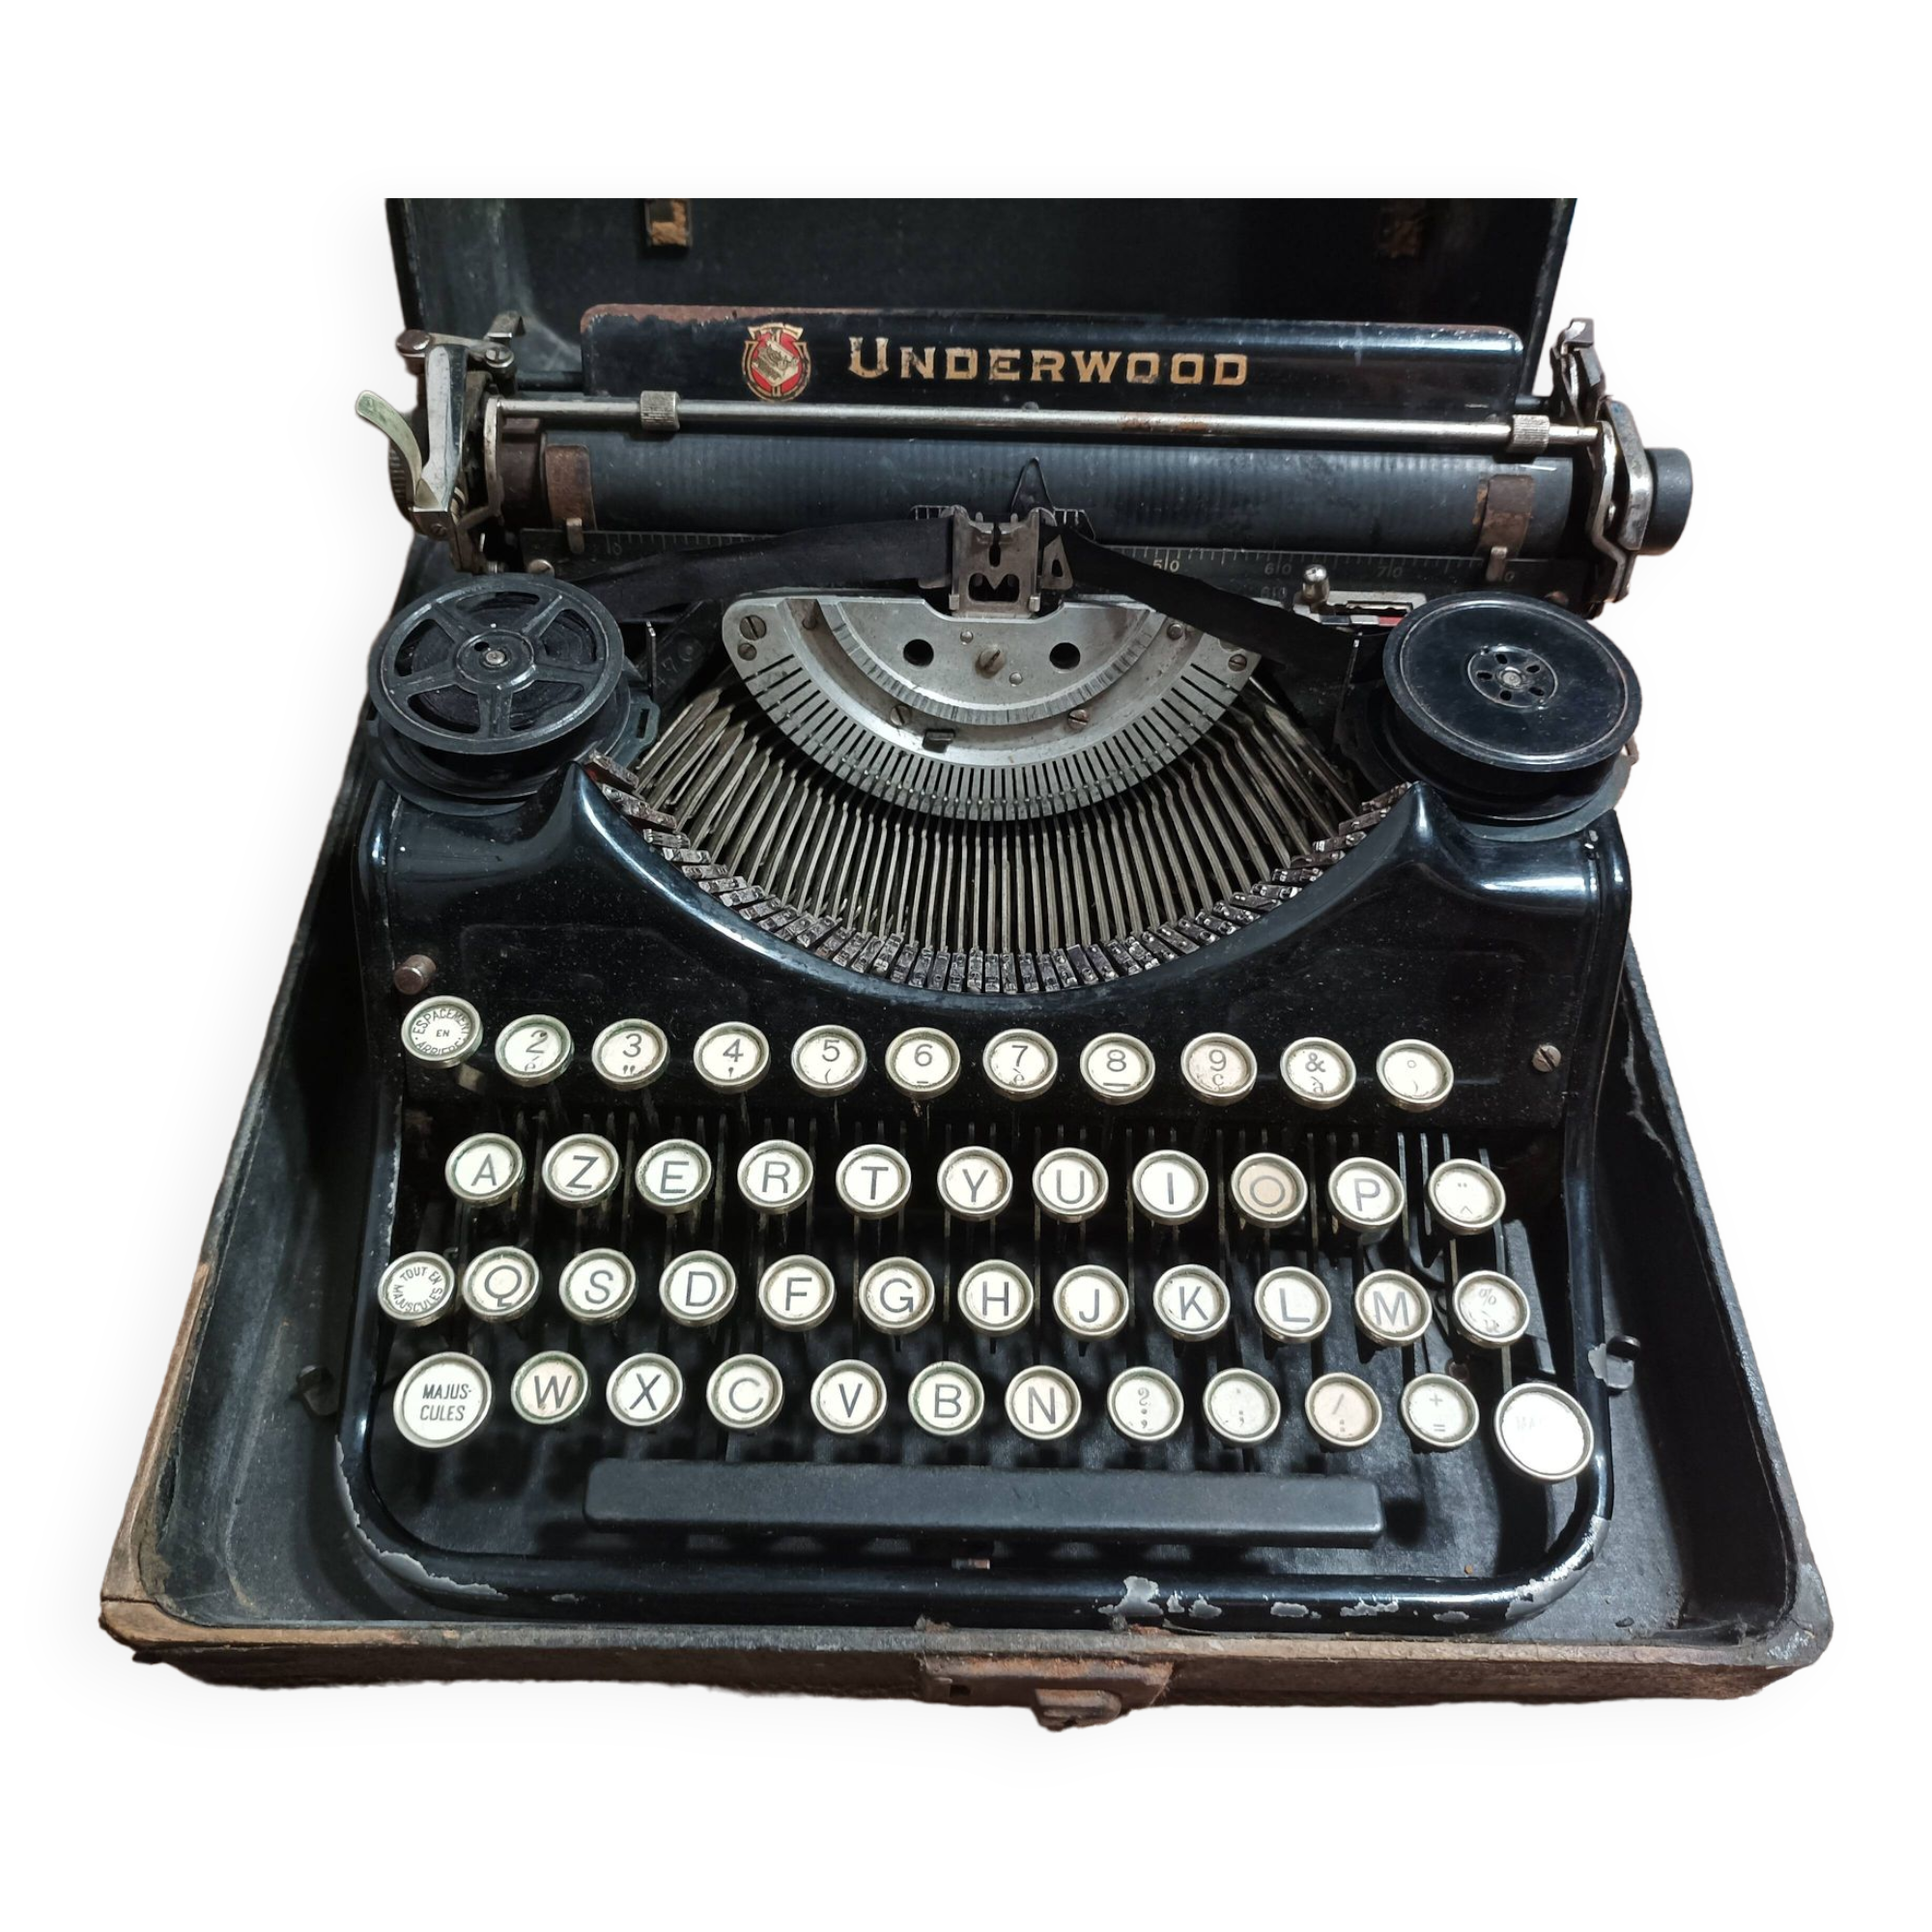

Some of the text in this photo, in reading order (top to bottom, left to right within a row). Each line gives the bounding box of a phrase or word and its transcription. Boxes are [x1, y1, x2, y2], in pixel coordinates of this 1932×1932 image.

[848, 336, 1249, 386] UNDERWOOD
[436, 1029, 460, 1037] EN
[525, 1030, 550, 1054] 2
[622, 1033, 642, 1058] 3
[722, 1038, 745, 1063] 4
[821, 1038, 840, 1063] 5
[913, 1043, 934, 1067] 6
[1010, 1044, 1030, 1067] 7
[1105, 1049, 1128, 1073] 8
[1208, 1048, 1228, 1072] 9
[1304, 1052, 1326, 1073] &
[470, 1153, 498, 1186] A
[565, 1154, 600, 1190] Z
[660, 1160, 690, 1195] E
[761, 1161, 789, 1195] R
[861, 1165, 890, 1201] T
[962, 1169, 989, 1204] Y
[1055, 1169, 1085, 1205] U
[1166, 1172, 1175, 1206] I
[1249, 1175, 1286, 1208] O
[1353, 1178, 1381, 1211] P
[399, 1266, 429, 1282] TOUT
[428, 1270, 443, 1286] EN
[484, 1264, 524, 1308] Q
[583, 1269, 615, 1305] S
[684, 1270, 718, 1307] D
[392, 1284, 444, 1313] MAJUSCULES
[784, 1276, 813, 1311] F
[879, 1277, 915, 1314] G
[981, 1281, 1010, 1317] H
[1077, 1288, 1101, 1323] J
[1178, 1285, 1209, 1321] K
[1279, 1288, 1312, 1323] L
[1373, 1291, 1411, 1326] M
[533, 1375, 574, 1409] W
[629, 1373, 663, 1411] X
[727, 1377, 765, 1414] C
[838, 1382, 864, 1419] V
[932, 1383, 963, 1419] B
[1027, 1386, 1057, 1425] N
[419, 1405, 466, 1422] CULES
